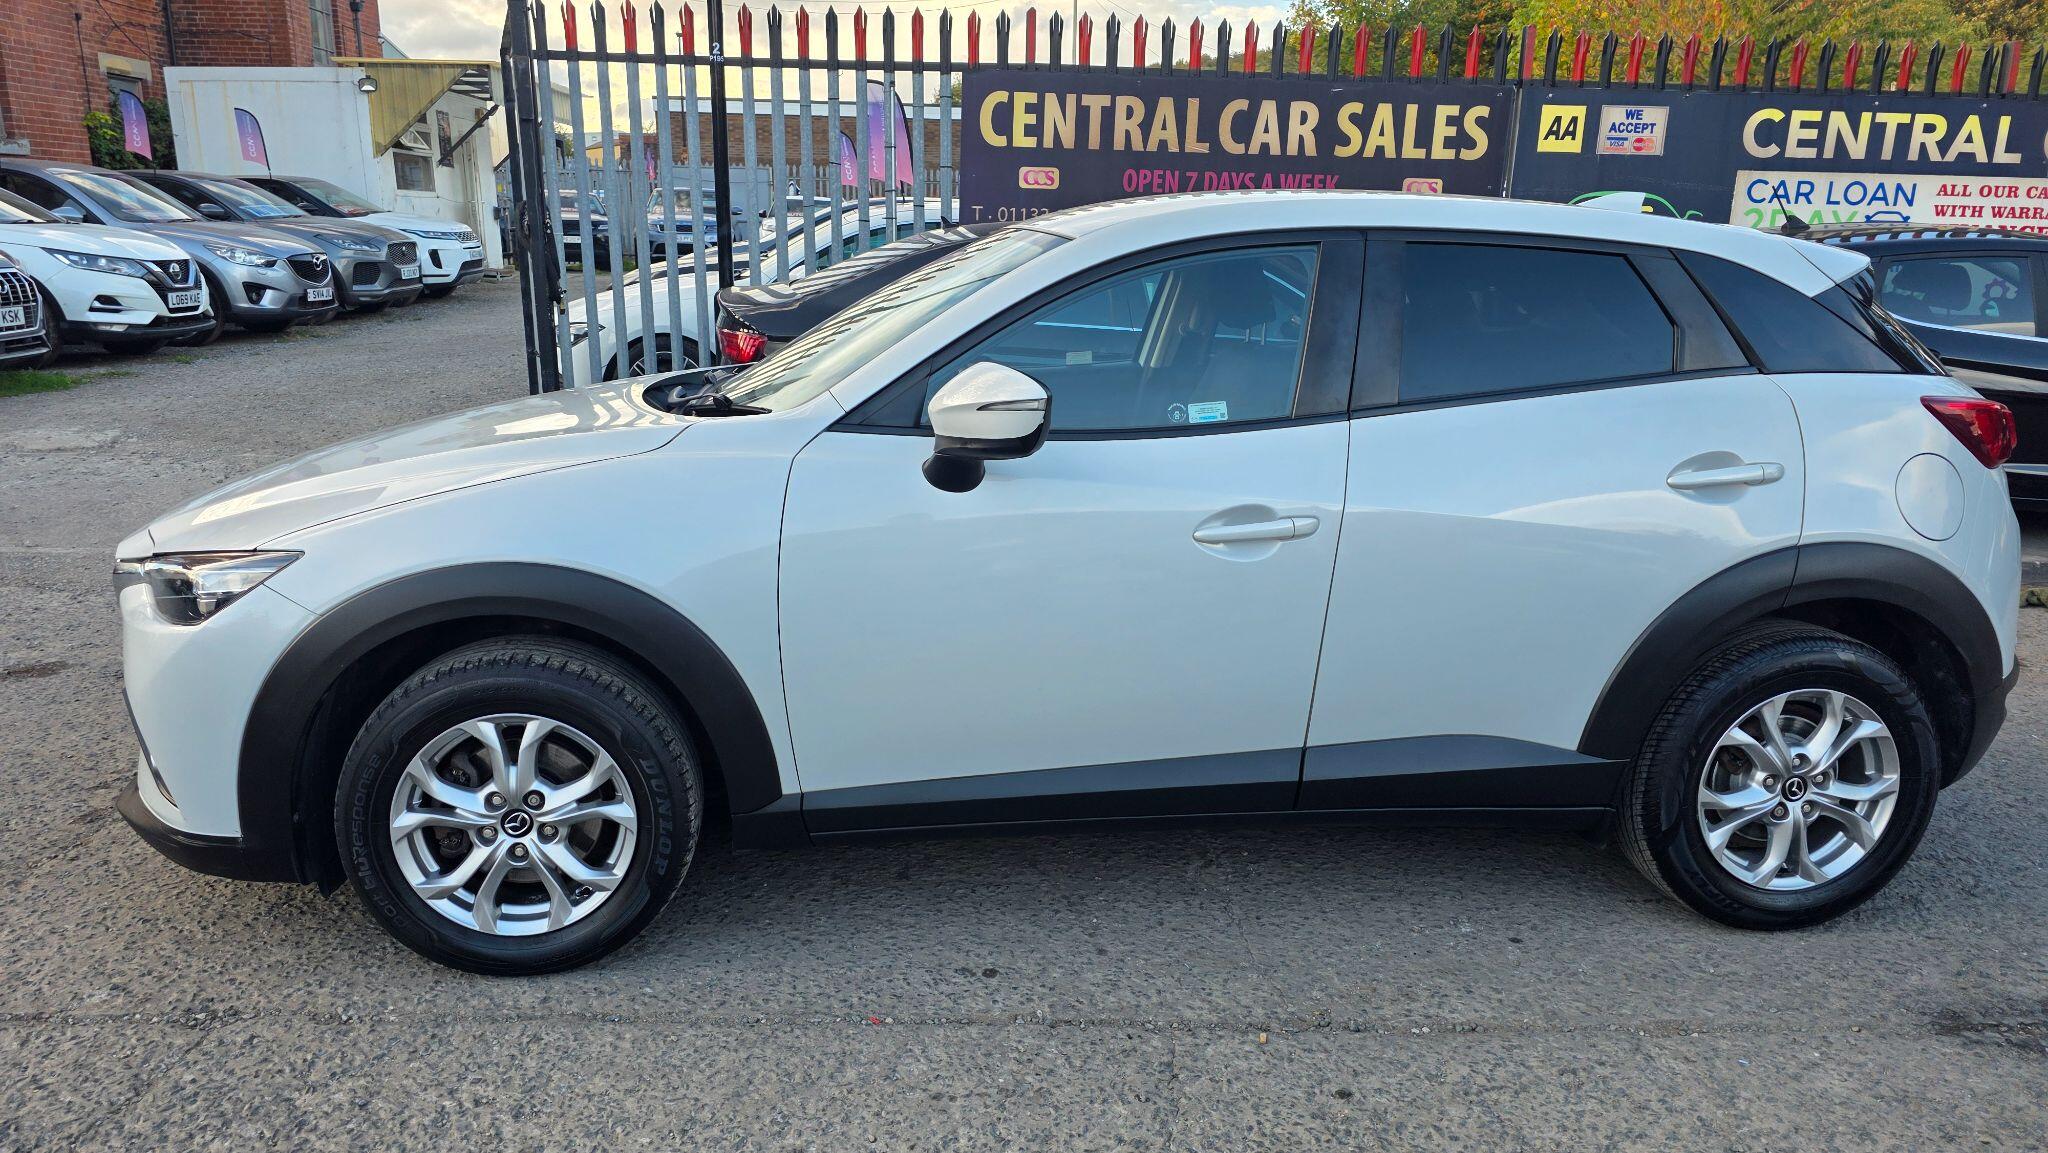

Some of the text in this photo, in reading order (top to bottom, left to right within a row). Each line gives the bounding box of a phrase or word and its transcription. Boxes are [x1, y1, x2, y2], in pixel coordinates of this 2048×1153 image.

[713, 42, 720, 54] 2
[1625, 109, 1644, 120] WE
[979, 91, 1491, 161] CENTRAL CAR SALES
[1543, 116, 1578, 141] AA
[1608, 122, 1656, 134] ACCEPT
[1742, 108, 2022, 164] CENTRAL
[1122, 169, 1341, 193] OPEN 7 DAYS A WEEK
[1746, 179, 1918, 207] CAR LOAN
[1936, 184, 1972, 197] ALL
[1979, 185, 2019, 198] OUR
[1934, 205, 2048, 219] WITH WARR
[1, 310, 21, 323] KSK
